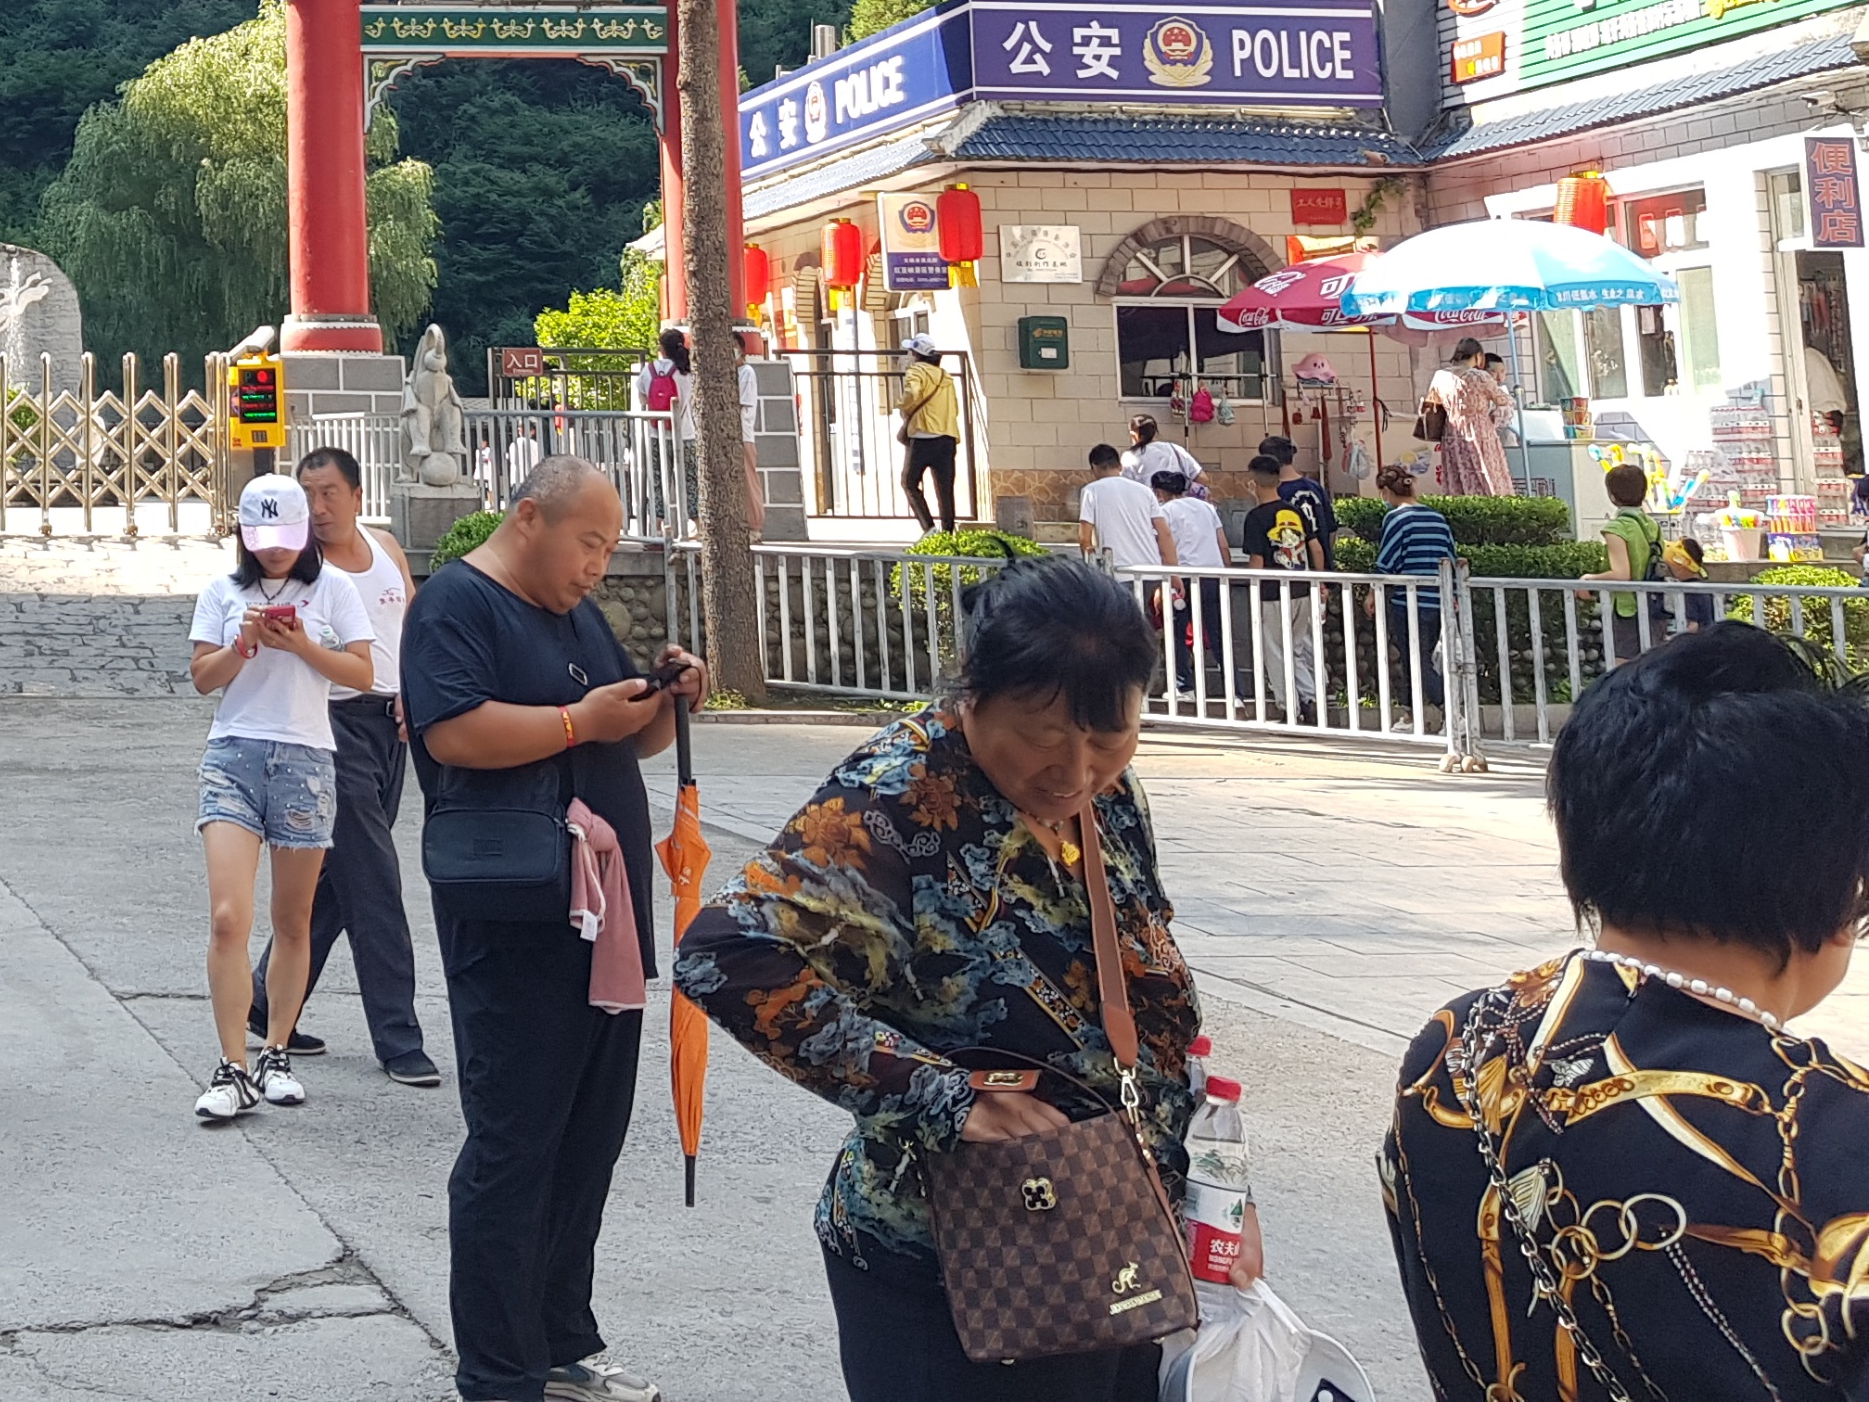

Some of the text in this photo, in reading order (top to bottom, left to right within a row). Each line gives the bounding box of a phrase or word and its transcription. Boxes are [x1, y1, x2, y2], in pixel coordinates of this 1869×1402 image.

[1002, 21, 1355, 81] 公安 POLICE
[749, 55, 905, 158] 公安 POLICE
[1811, 141, 1858, 243] 便利店
[506, 353, 538, 368] 入口
